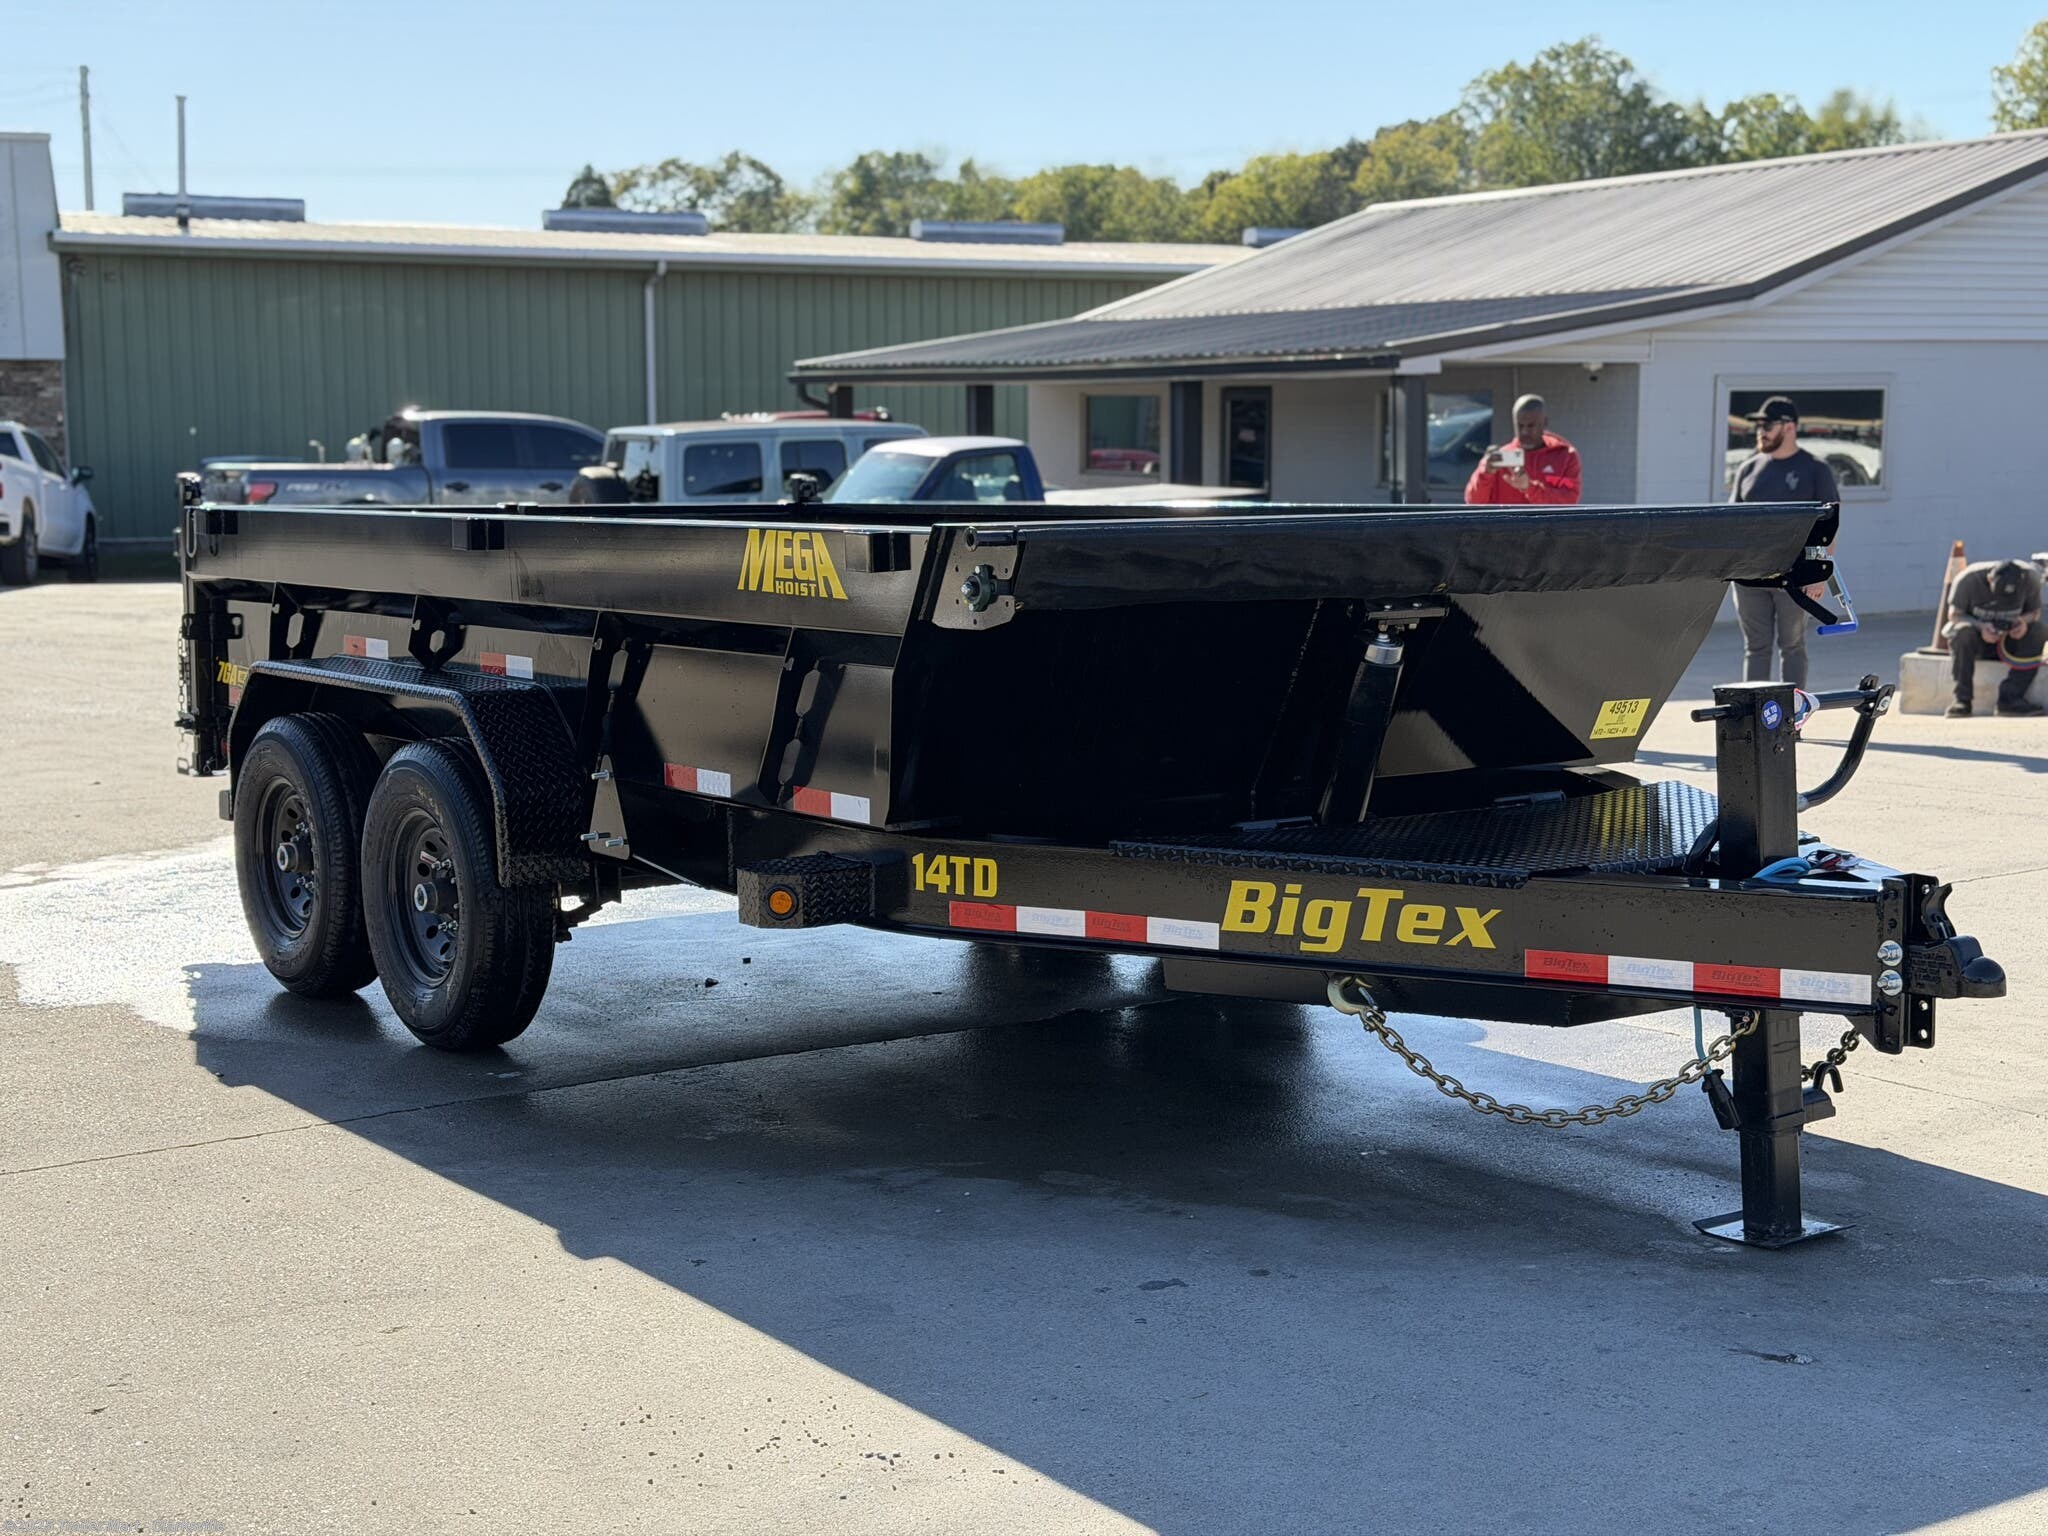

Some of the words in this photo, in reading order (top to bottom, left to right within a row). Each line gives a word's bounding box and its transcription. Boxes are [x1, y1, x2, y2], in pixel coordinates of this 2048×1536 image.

[737, 529, 848, 600] MEGA
[775, 581, 817, 598] HOIST
[1609, 701, 1640, 715] 49513
[911, 852, 998, 898] 14TD
[1221, 880, 1503, 953] BigTex
